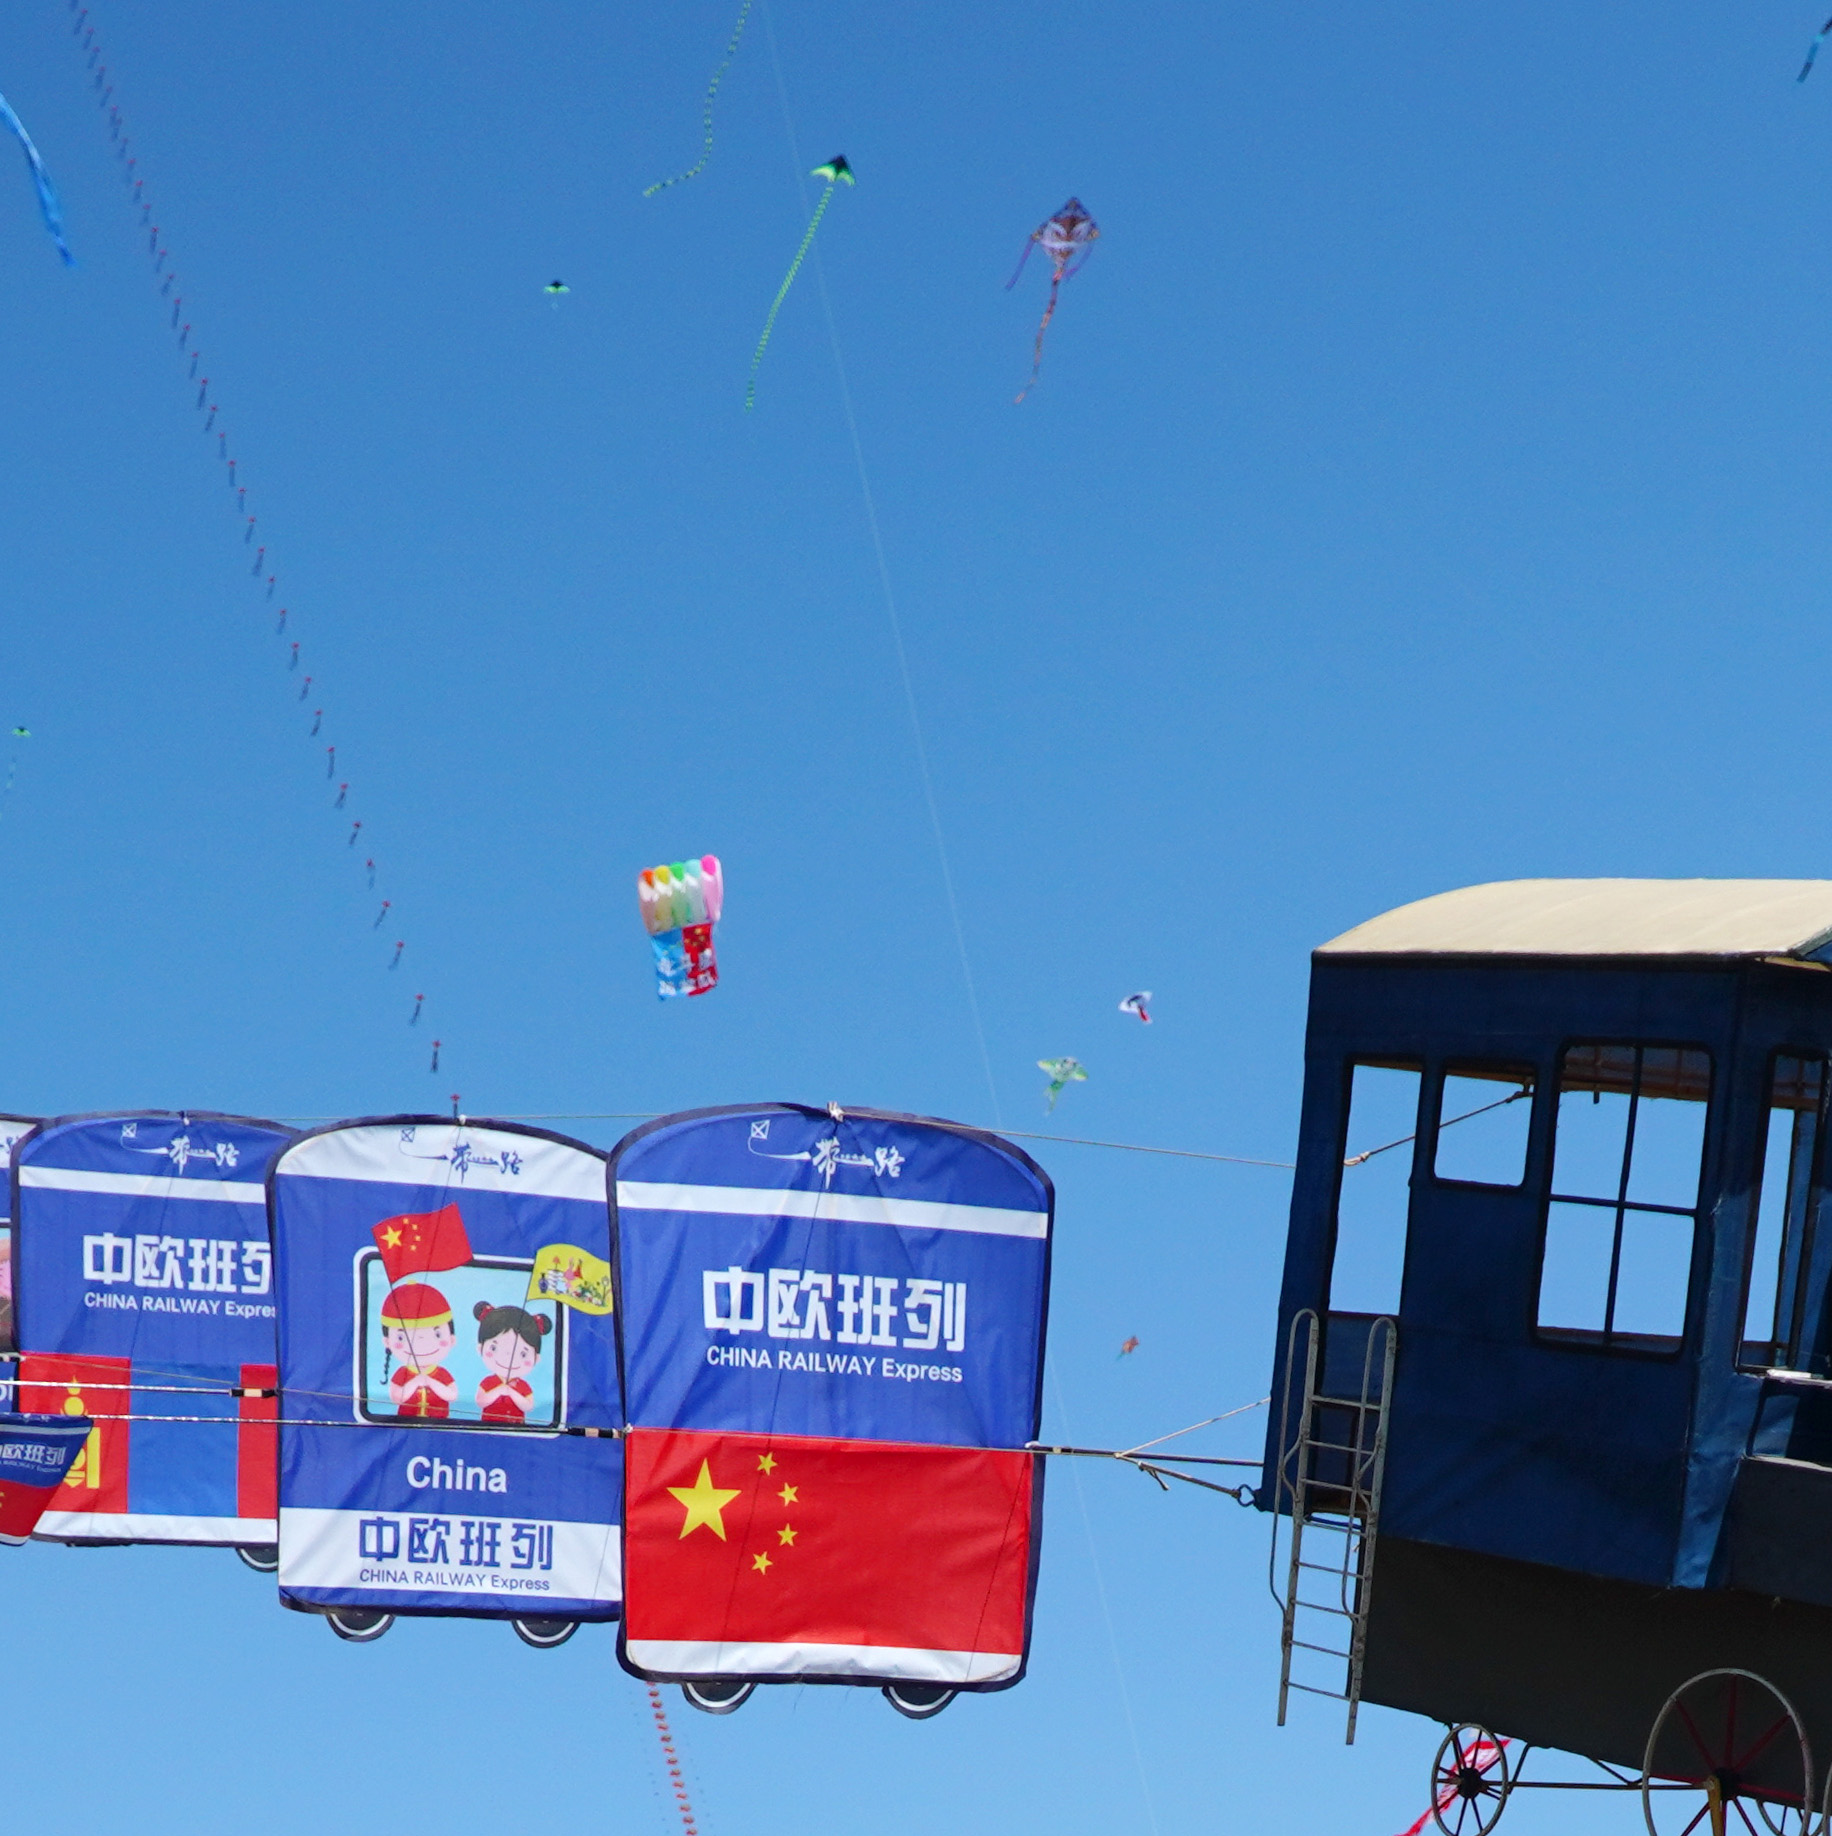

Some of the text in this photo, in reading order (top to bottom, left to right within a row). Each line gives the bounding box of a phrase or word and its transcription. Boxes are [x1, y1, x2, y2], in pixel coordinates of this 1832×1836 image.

[84, 1292, 276, 1319] CHINA RAILWAY Expre
[702, 1266, 965, 1352] 中欧班列
[706, 1345, 963, 1383] CHINA RAILWAY Express
[406, 1456, 507, 1493] China
[359, 1516, 553, 1570] 中欧班列
[359, 1569, 550, 1591] CHINA RAILWAY Express
